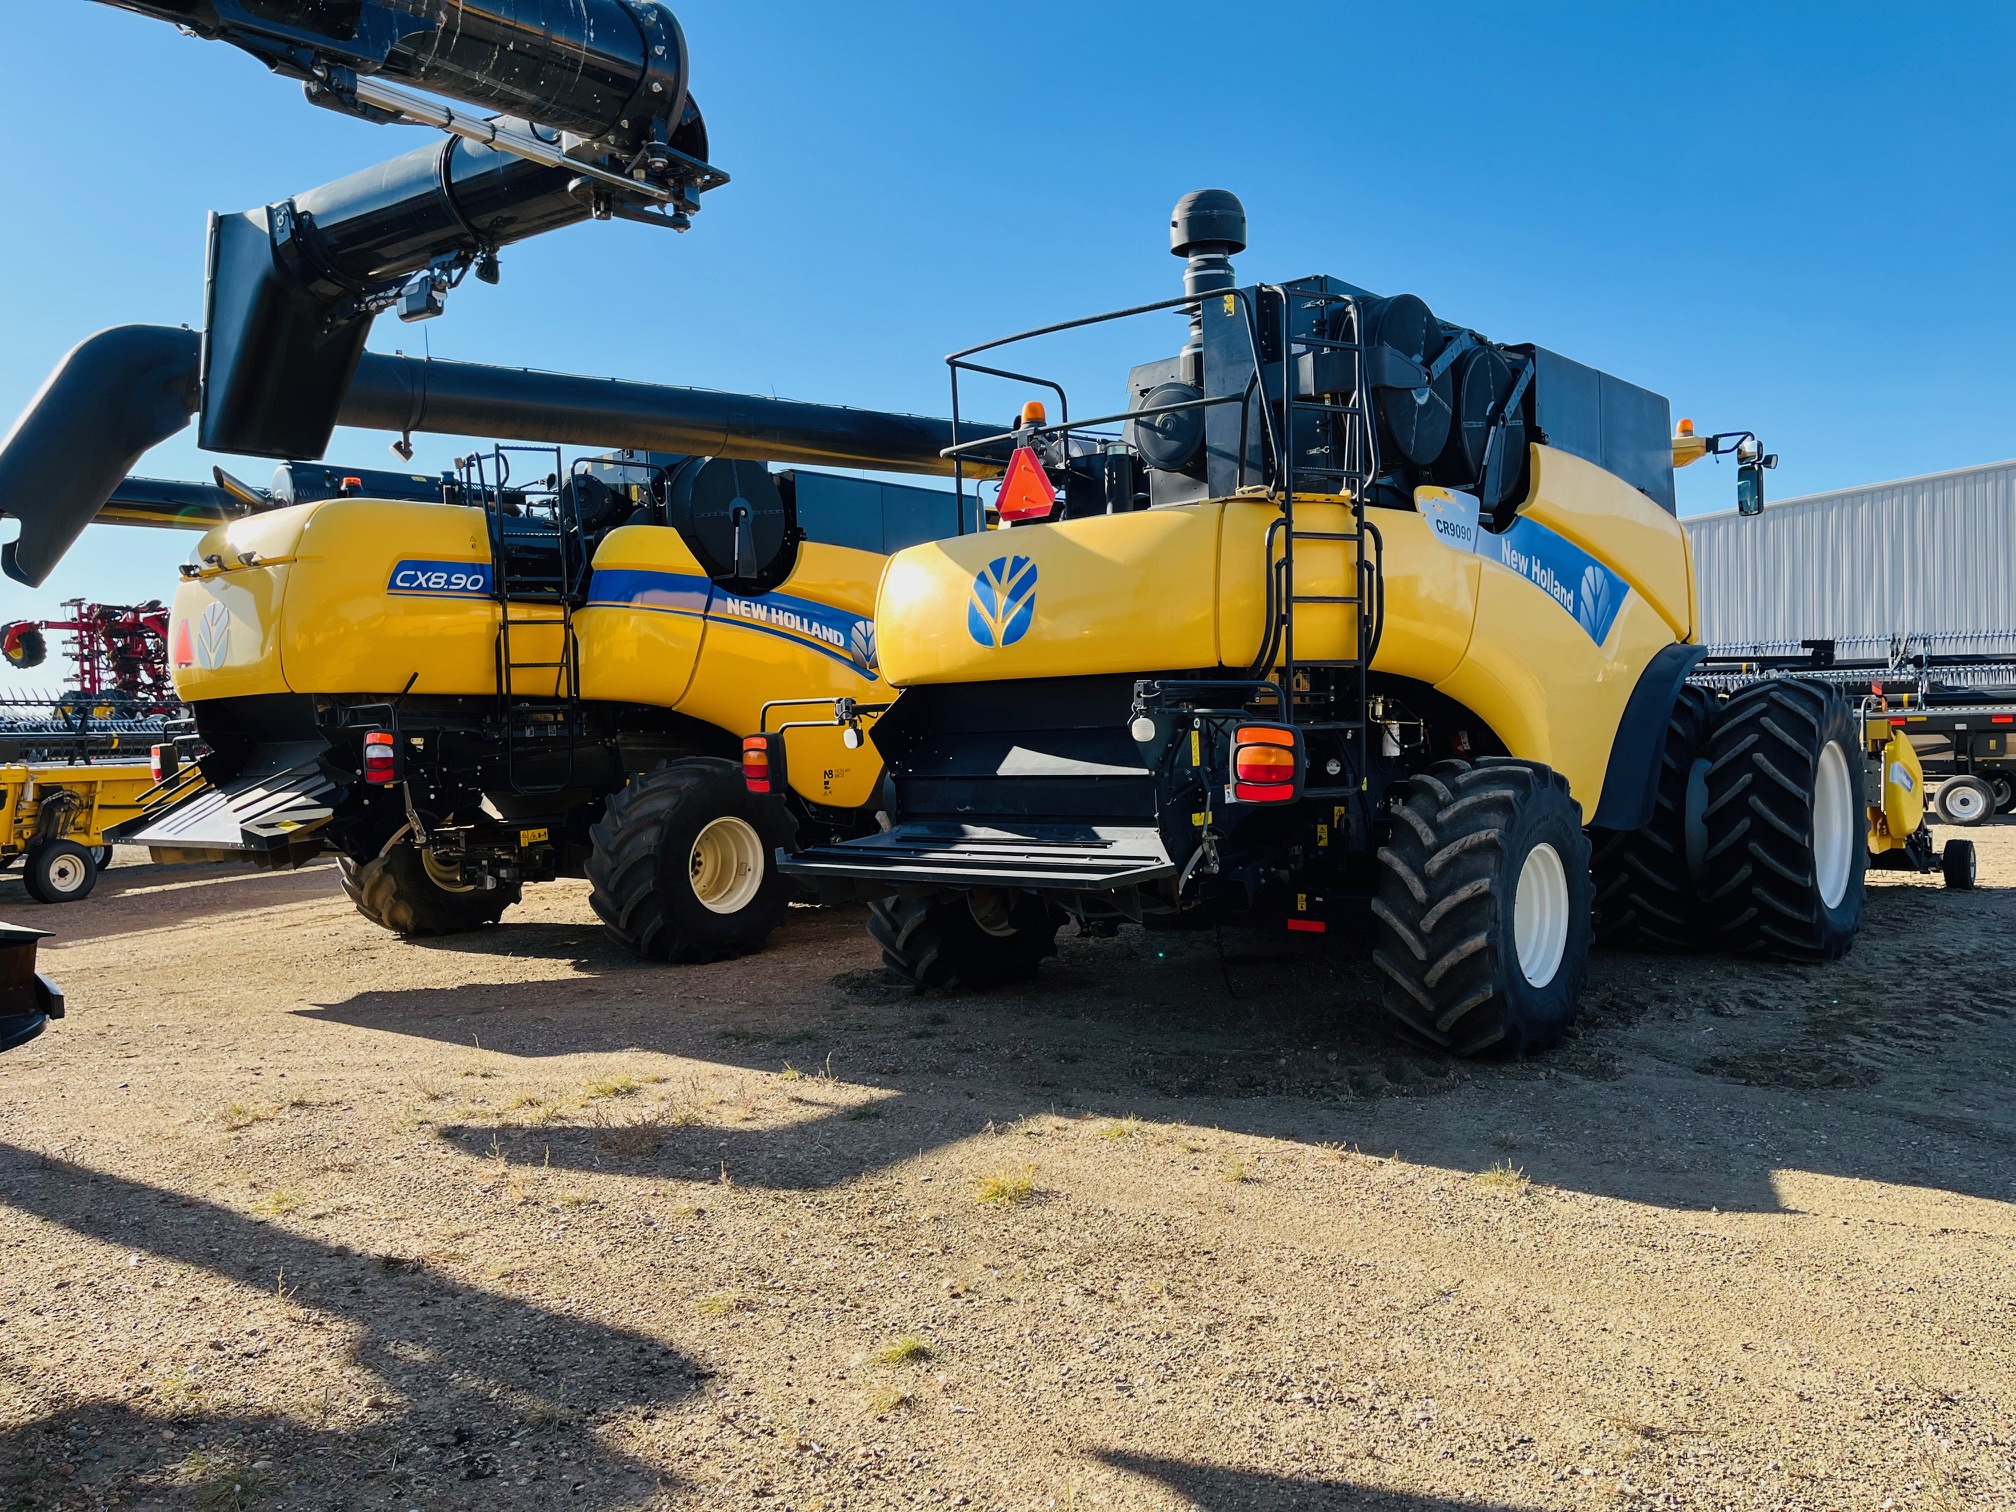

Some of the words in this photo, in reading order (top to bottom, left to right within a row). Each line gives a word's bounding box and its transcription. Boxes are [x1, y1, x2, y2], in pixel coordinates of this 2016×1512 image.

[1436, 519, 1472, 542] CR9090
[395, 570, 484, 591] CX8.90
[1501, 537, 1529, 575] New
[1531, 555, 1574, 614] Holland
[726, 597, 768, 621] NEW
[771, 607, 845, 647] HOLLAND
